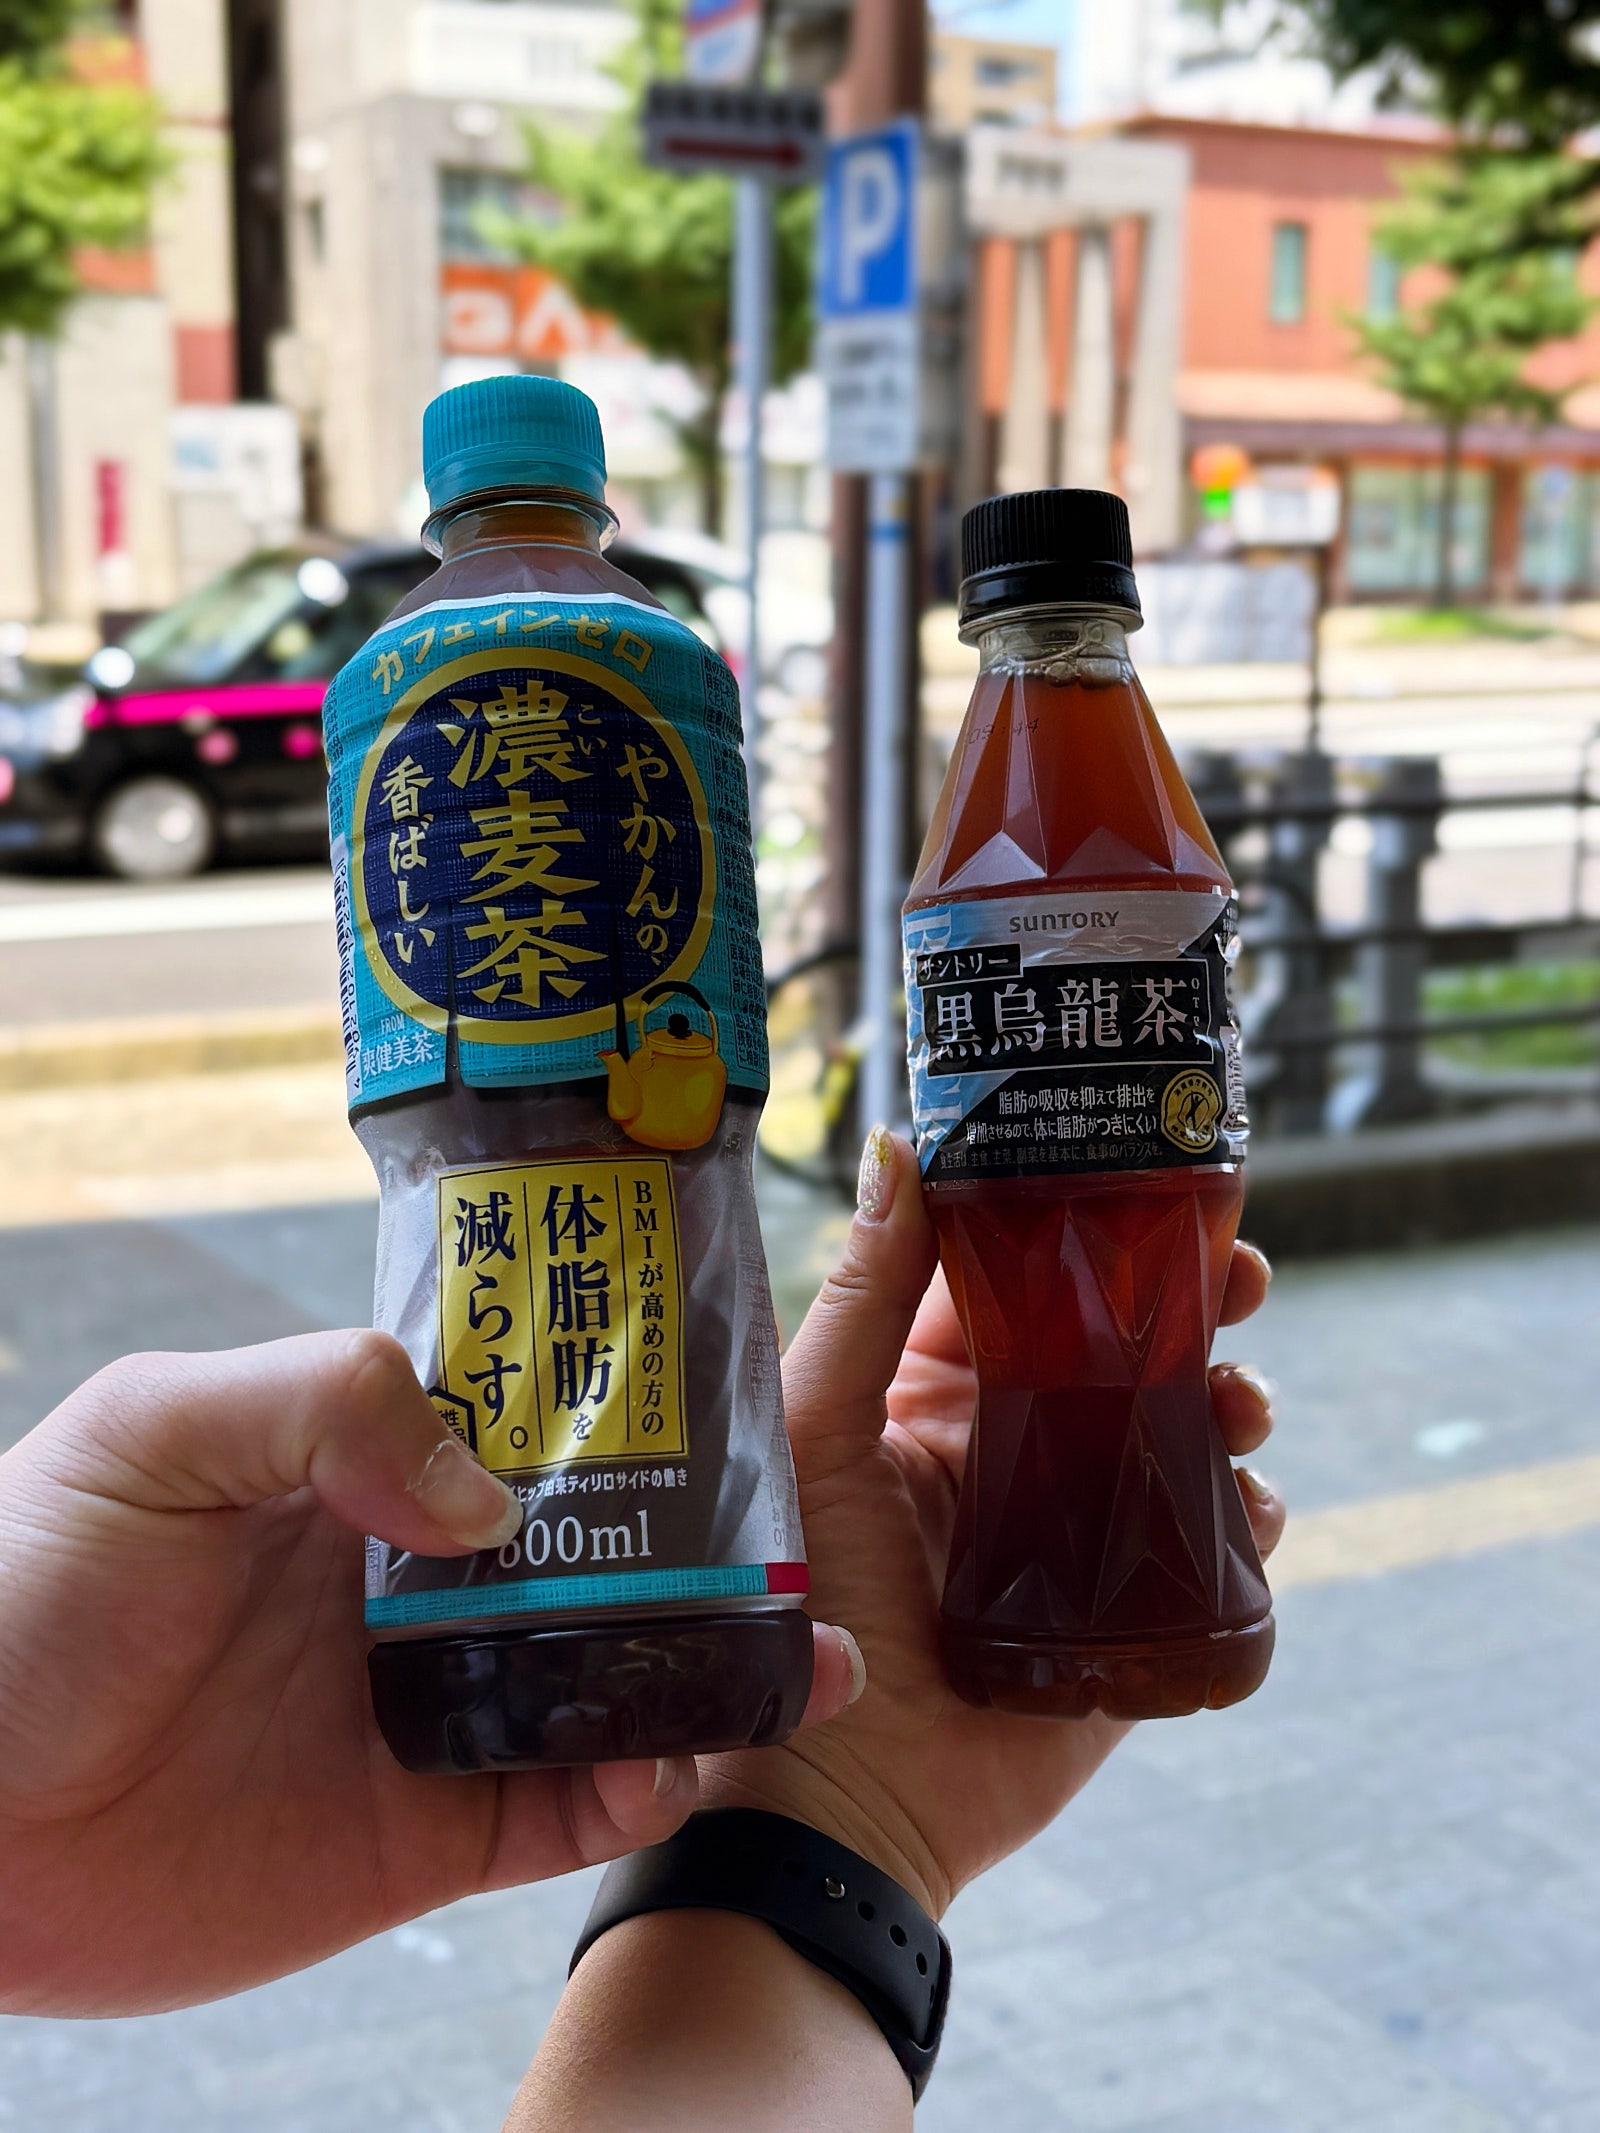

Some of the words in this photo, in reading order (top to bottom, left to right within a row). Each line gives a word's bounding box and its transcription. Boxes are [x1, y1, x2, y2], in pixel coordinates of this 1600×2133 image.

[838, 151, 900, 304] P
[371, 609, 654, 695] カフェインゼロ
[576, 703, 607, 756] こい
[379, 755, 436, 964] 香ばしい
[436, 680, 608, 1008] 濃麦茶
[615, 743, 678, 966] やかんの
[1009, 911, 1120, 932] SUNTORY
[920, 952, 1009, 980] サントリー
[362, 1030, 435, 1080] 爽健美茶
[381, 1013, 405, 1034] FROM
[936, 977, 1188, 1060] 黒烏龍茶
[999, 1083, 1155, 1115] 脂肪の吸収を抑えて排出を
[453, 1191, 529, 1450] 減らす。
[540, 1184, 616, 1441] 体脂肪を
[633, 1180, 665, 1436] BMIが高めの方の
